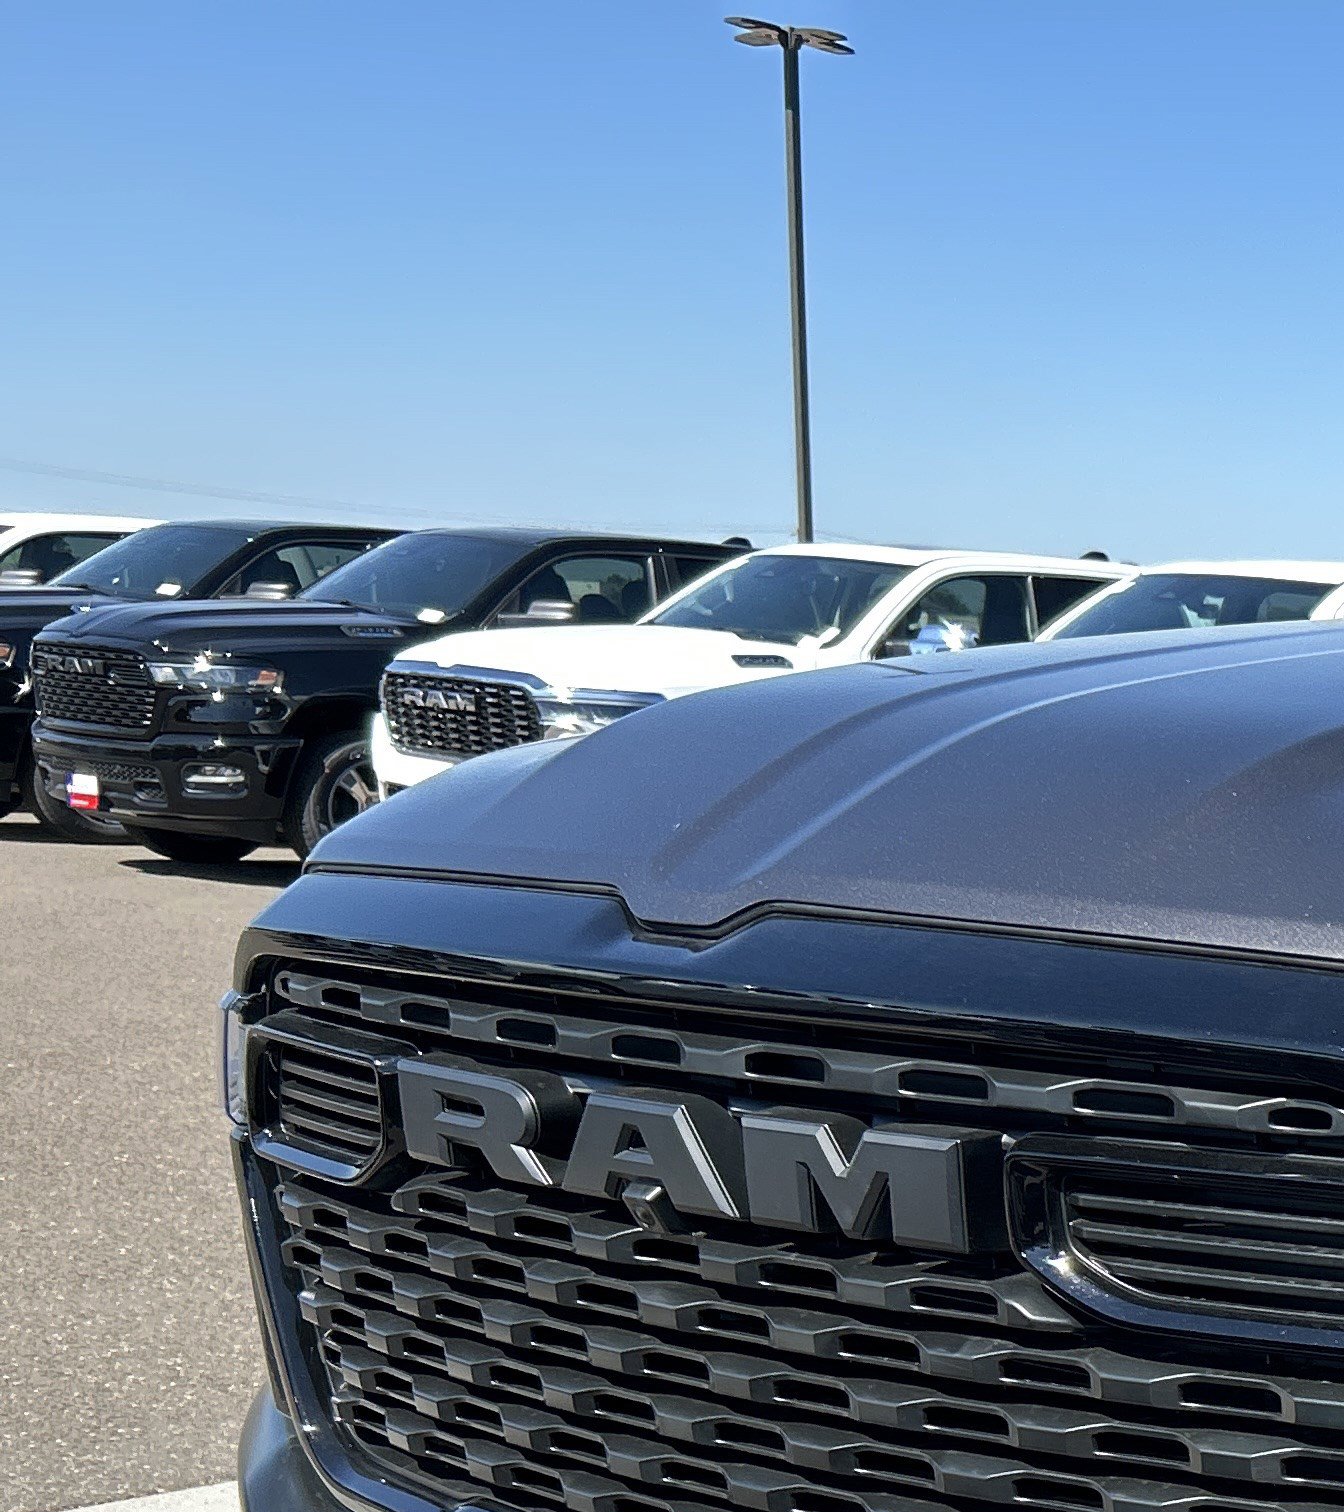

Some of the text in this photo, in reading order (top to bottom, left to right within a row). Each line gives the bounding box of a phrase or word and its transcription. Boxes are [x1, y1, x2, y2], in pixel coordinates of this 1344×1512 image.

[47, 654, 104, 674] RAM
[402, 688, 477, 711] RAM
[398, 1057, 970, 1253] RAM
